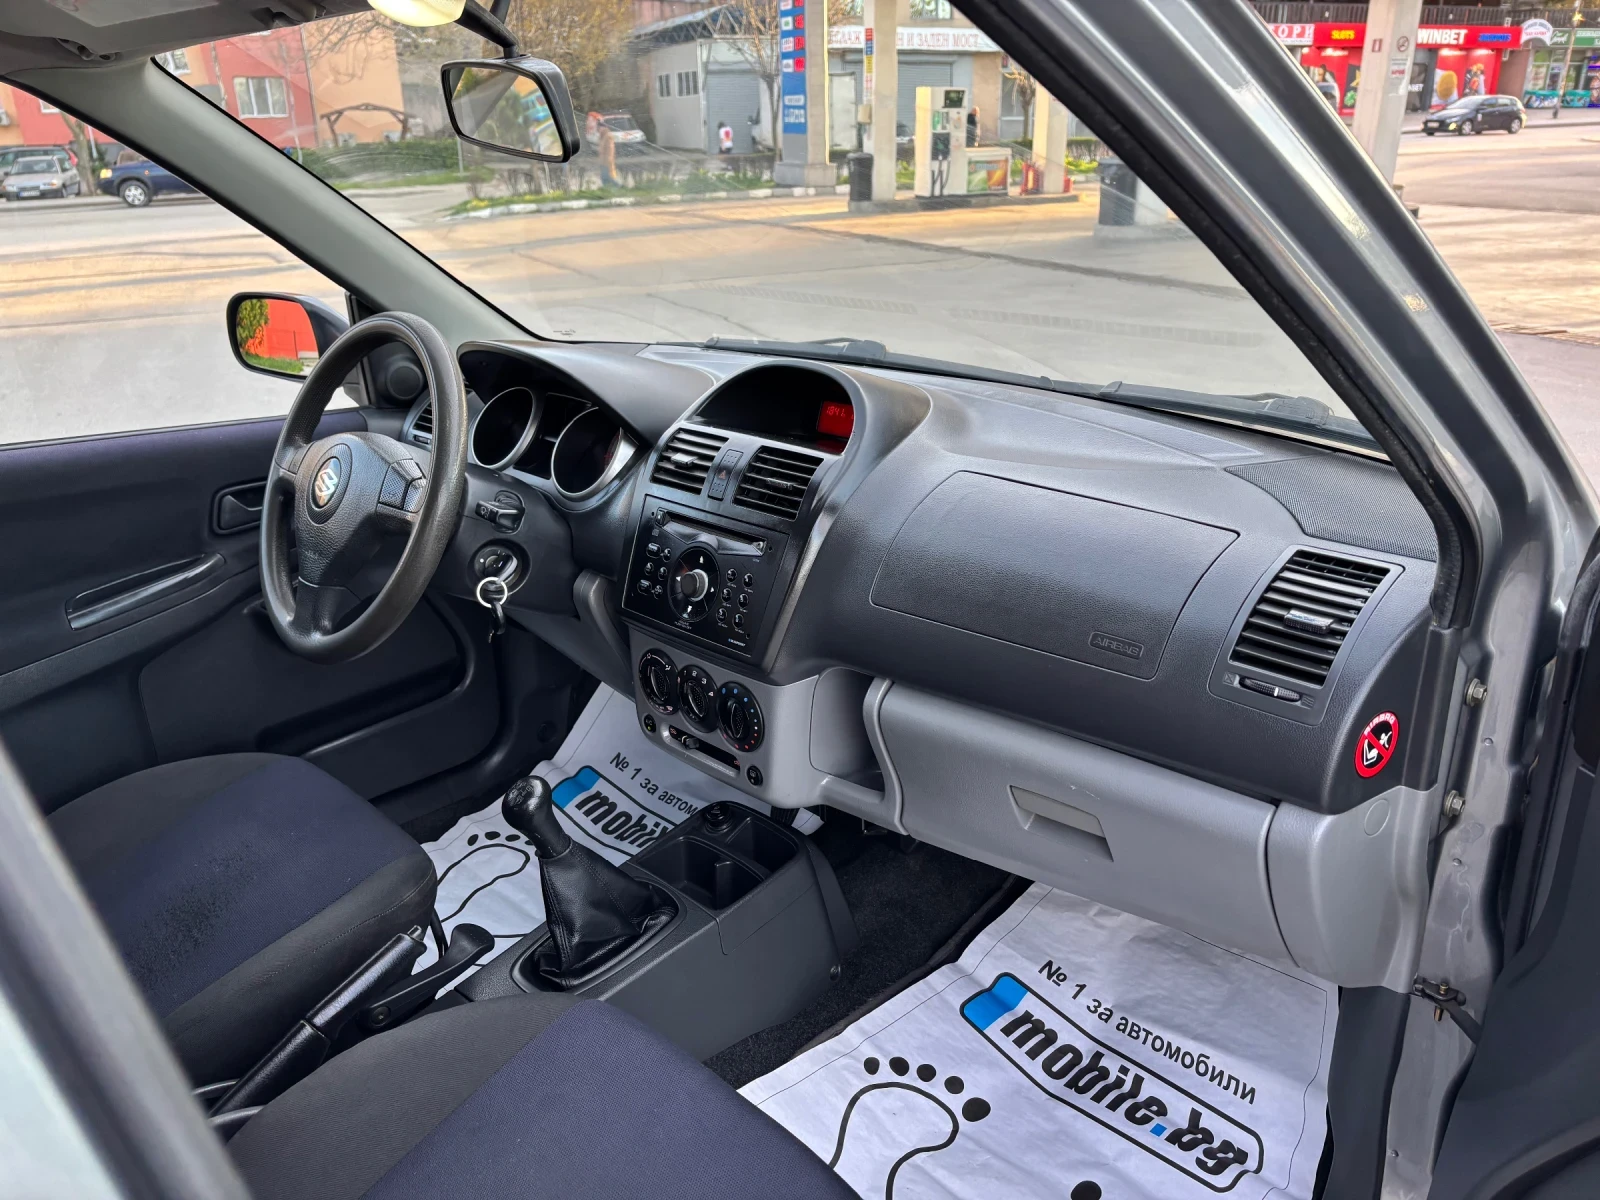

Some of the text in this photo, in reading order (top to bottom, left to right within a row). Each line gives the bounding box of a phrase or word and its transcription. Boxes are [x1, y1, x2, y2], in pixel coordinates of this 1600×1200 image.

[917, 33, 950, 48] ЗАДЕН
[1417, 28, 1468, 45] WINBET
[1093, 637, 1140, 656] AIRBAG
[609, 752, 699, 816] № 1 за автом
[574, 790, 670, 848] mobil
[1038, 960, 1256, 1105] № 1 за автомобили
[1000, 1010, 1249, 1176] mobile.bg
